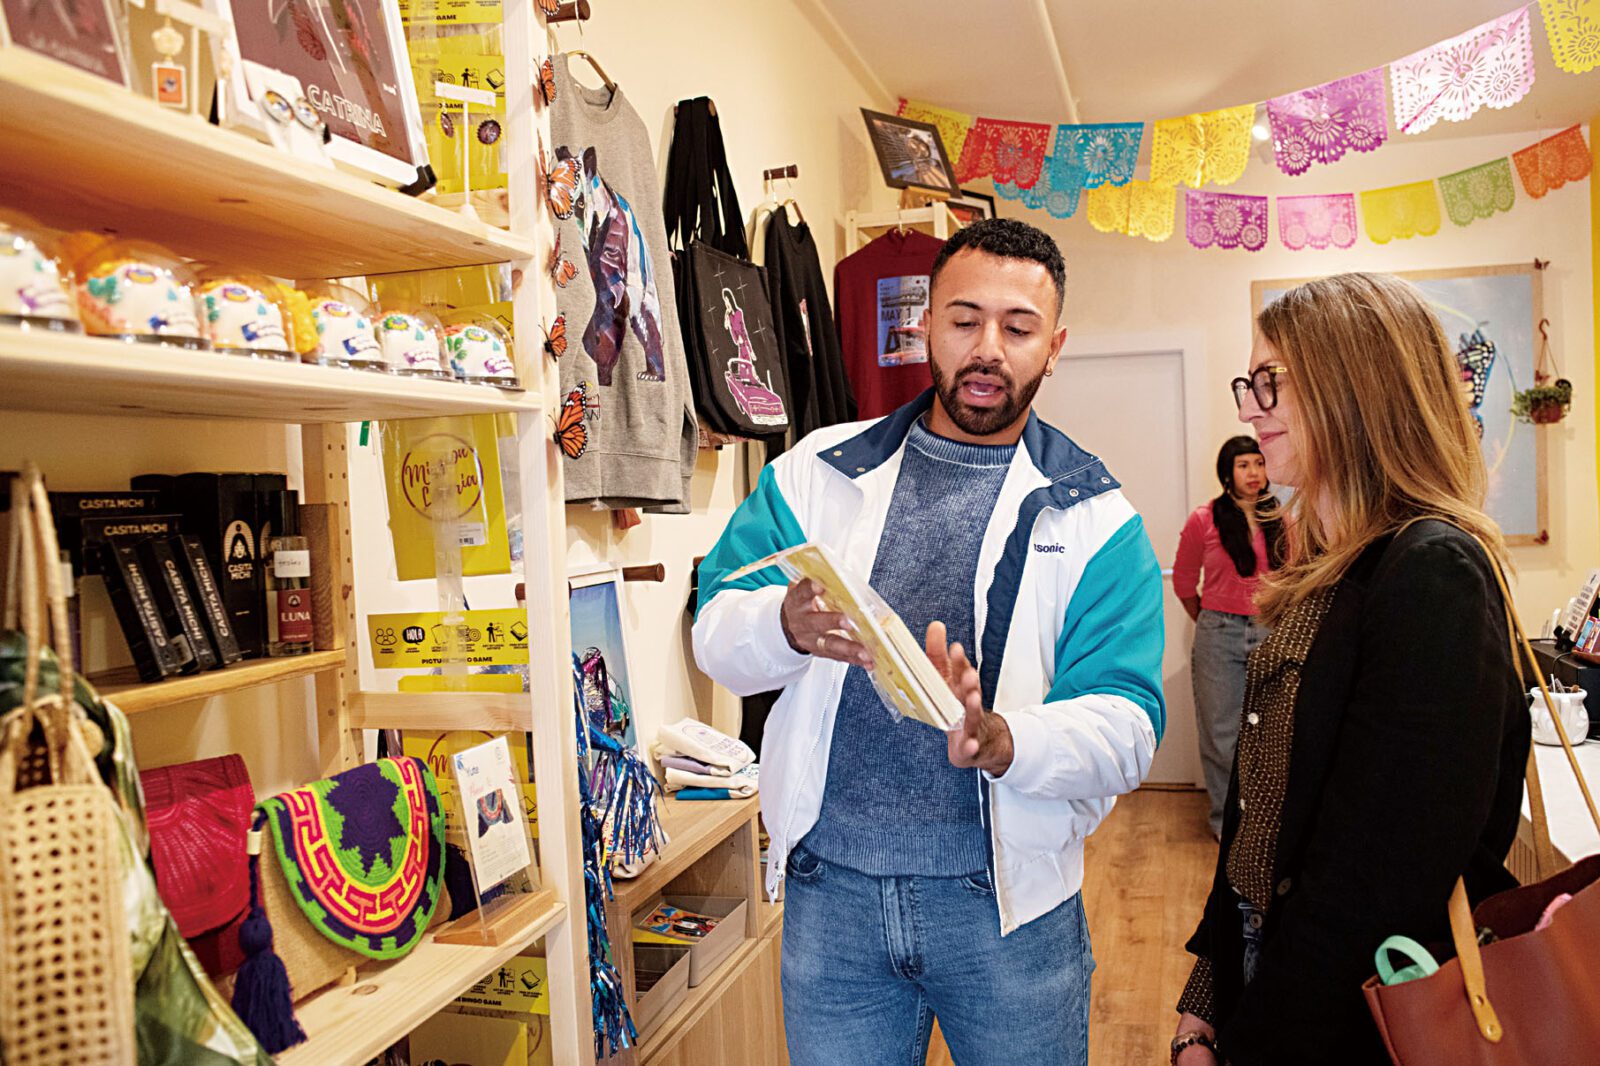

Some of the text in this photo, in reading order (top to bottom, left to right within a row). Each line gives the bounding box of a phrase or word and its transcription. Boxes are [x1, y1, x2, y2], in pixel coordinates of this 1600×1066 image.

[307, 84, 387, 138] CATRINA
[881, 309, 902, 321] MAY
[79, 498, 145, 510] CASITA MICHI
[104, 523, 168, 536] CASITA MICHI
[228, 563, 253, 573] CASITA
[231, 571, 251, 580] MICHI
[165, 560, 203, 640] CASITA MICHI
[194, 558, 230, 637] CASITA MICHI
[128, 564, 167, 647] CASITA MICHI
[281, 611, 311, 623] LUNA
[406, 628, 423, 641] HOLA
[483, 998, 502, 1006] GAME
